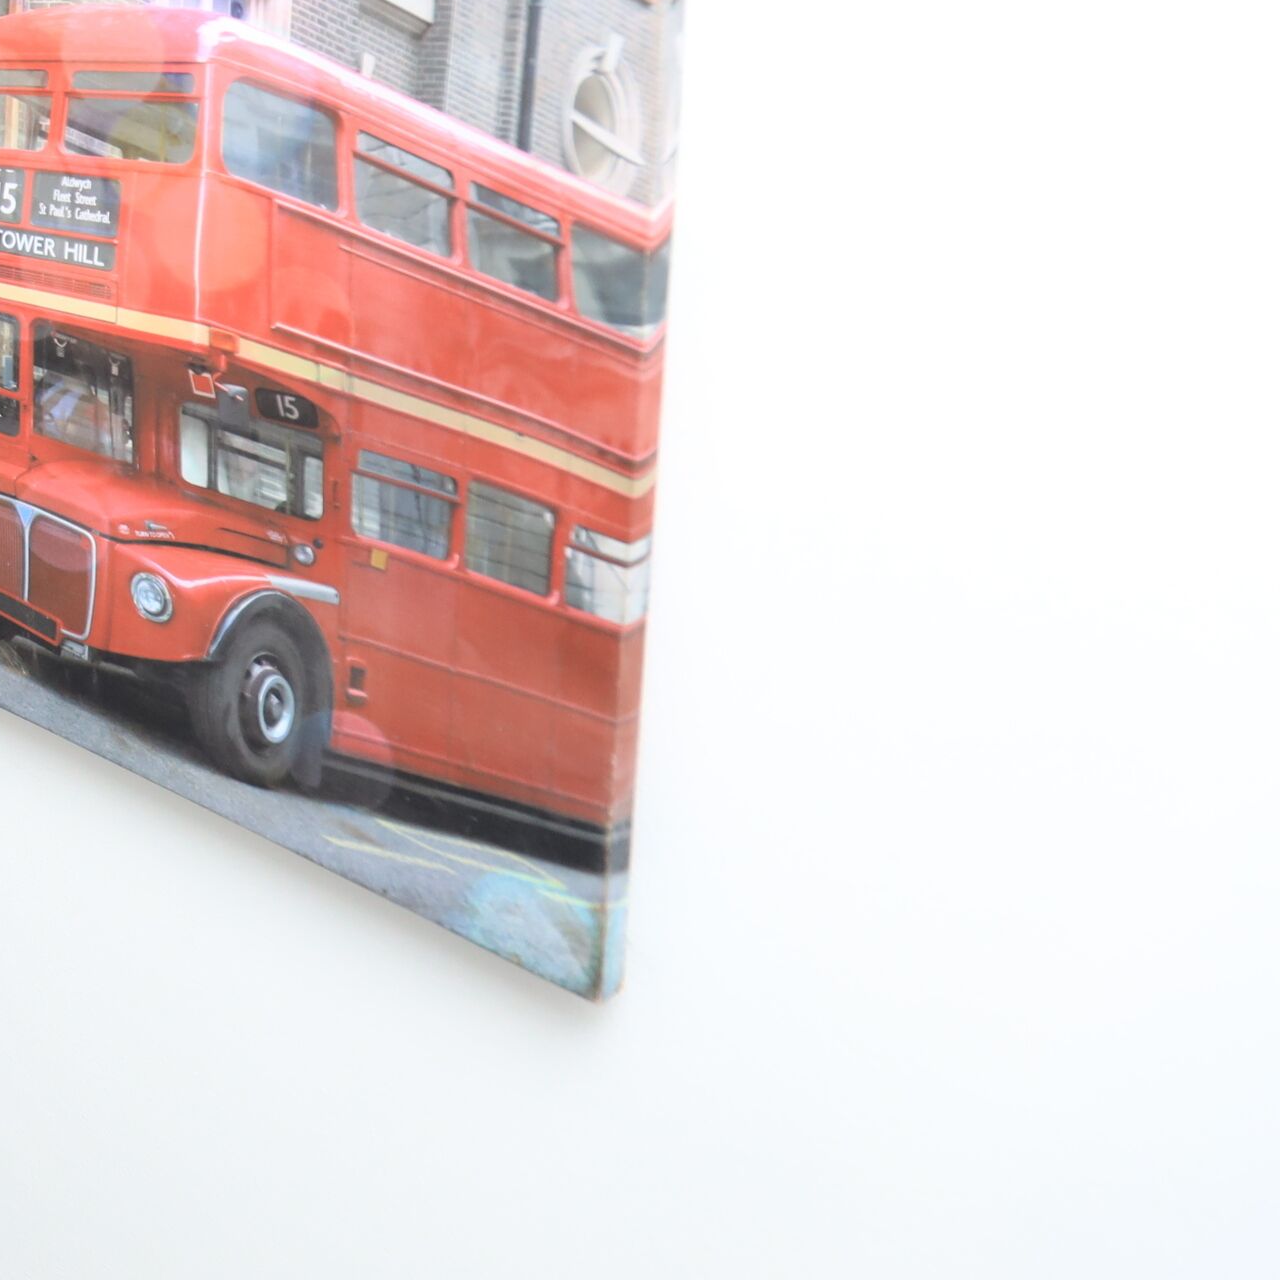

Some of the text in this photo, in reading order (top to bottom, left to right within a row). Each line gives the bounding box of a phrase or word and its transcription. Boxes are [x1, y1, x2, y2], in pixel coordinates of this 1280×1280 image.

[74, 191, 97, 207] Street
[63, 241, 106, 267] HILL
[275, 393, 300, 420] 15
